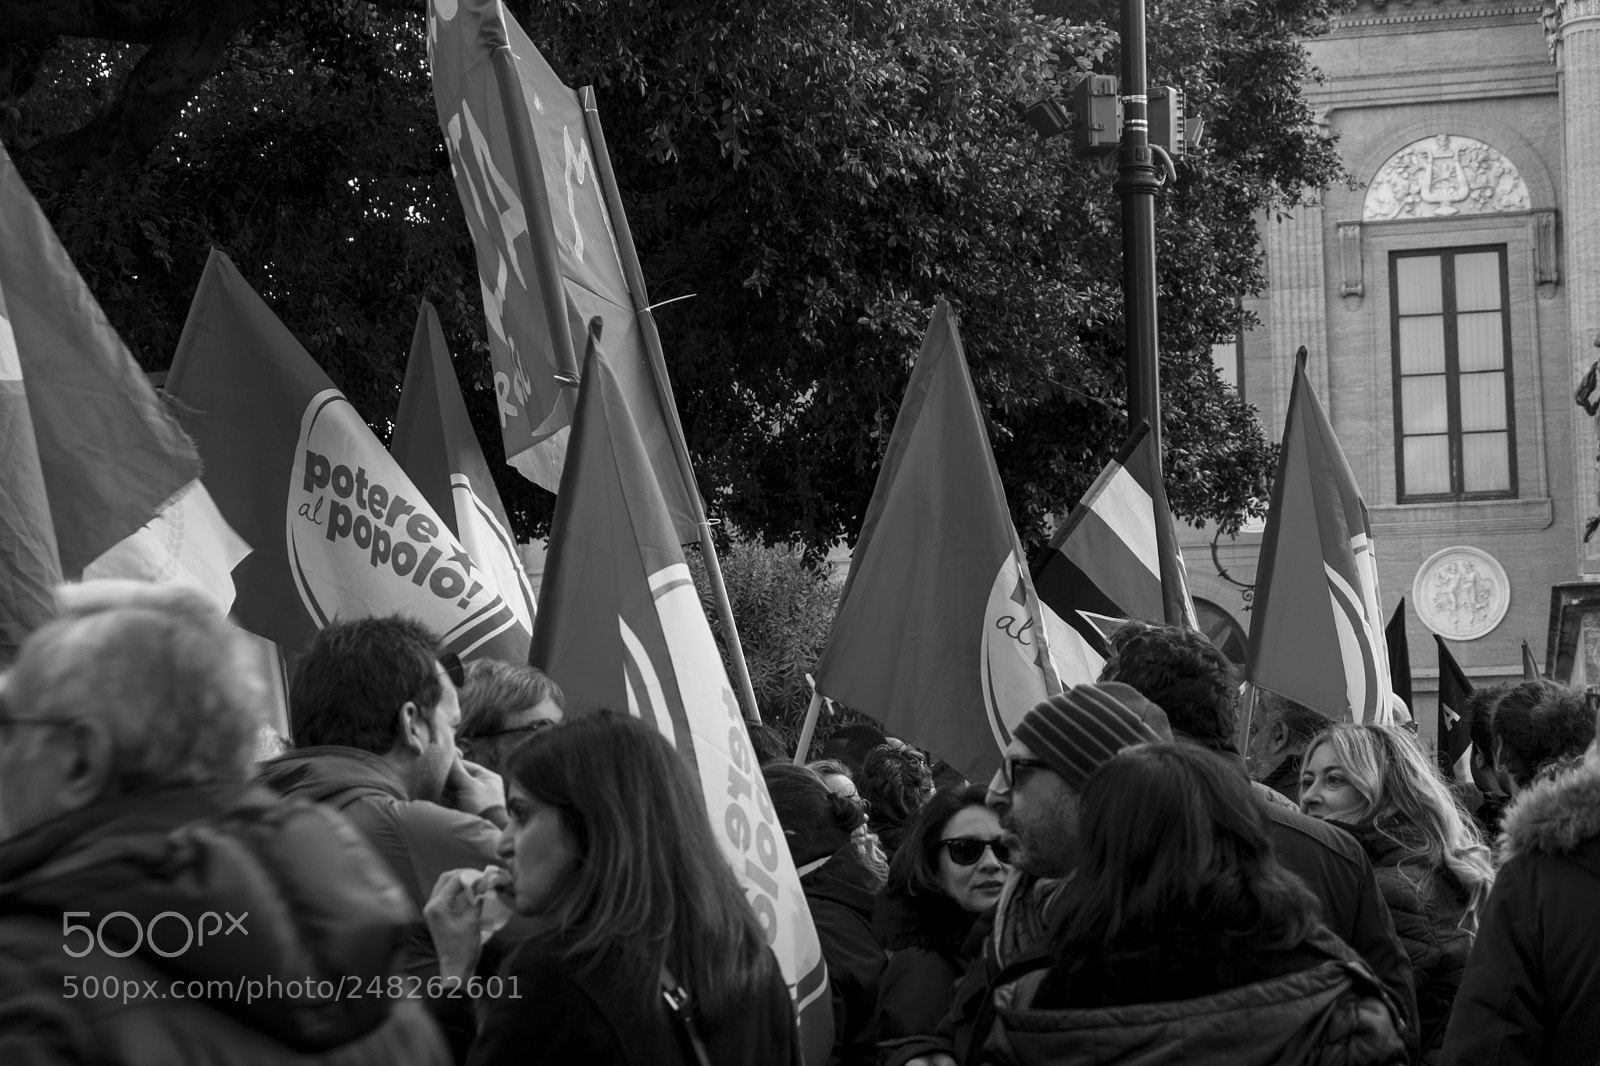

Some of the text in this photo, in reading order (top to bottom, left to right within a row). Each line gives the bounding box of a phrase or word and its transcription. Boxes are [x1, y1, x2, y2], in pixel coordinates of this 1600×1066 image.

[303, 449, 439, 543] potere
[298, 495, 484, 610] al popolo!
[996, 615, 1034, 646] al
